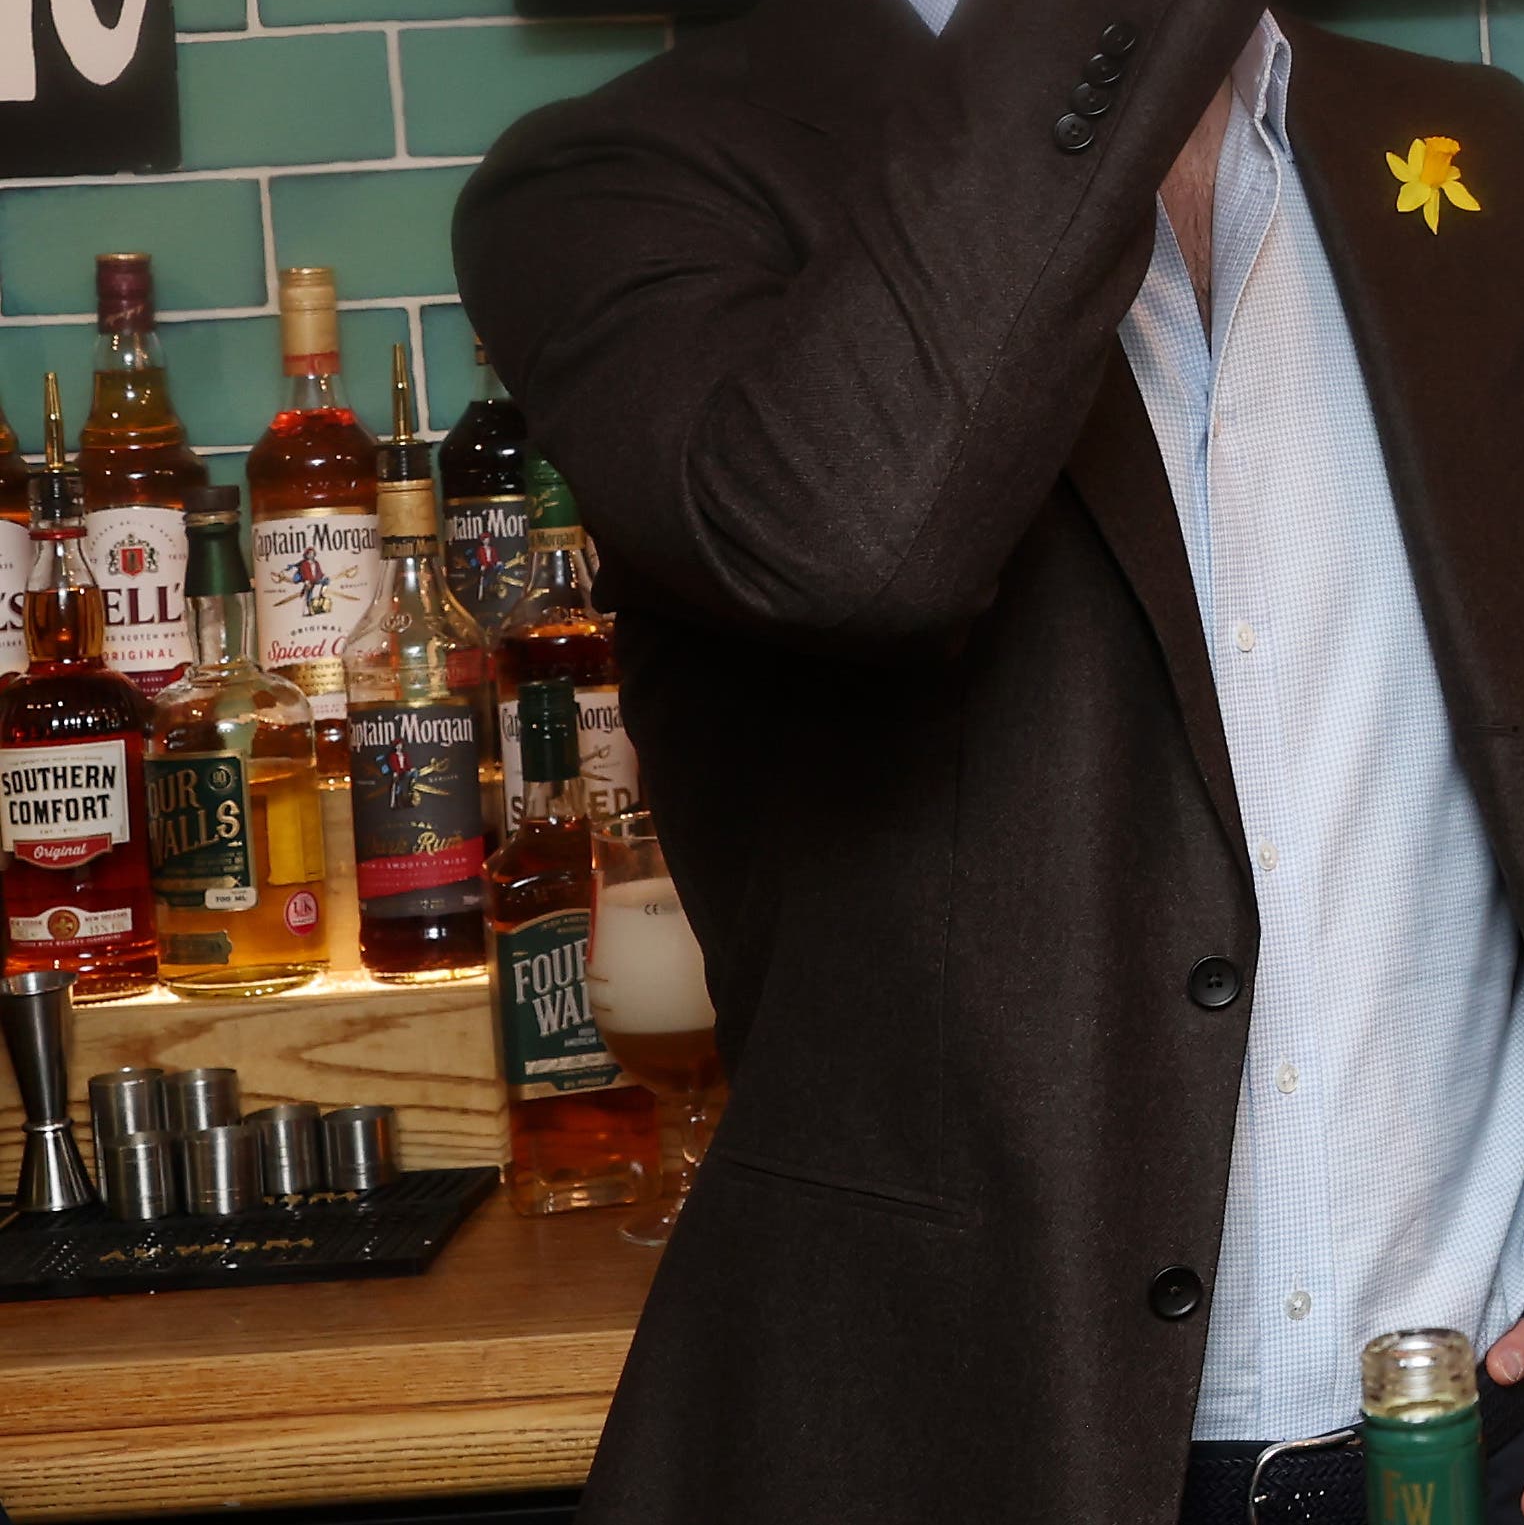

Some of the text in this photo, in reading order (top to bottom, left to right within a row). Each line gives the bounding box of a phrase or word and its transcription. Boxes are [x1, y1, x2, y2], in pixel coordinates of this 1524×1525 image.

[289, 626, 342, 637] ORIGINAL
[267, 638, 327, 664] Spiced
[401, 713, 474, 747] Morgan
[1, 765, 116, 796] SOUTHERN
[9, 793, 110, 825] COMFORT
[33, 842, 87, 861] Original
